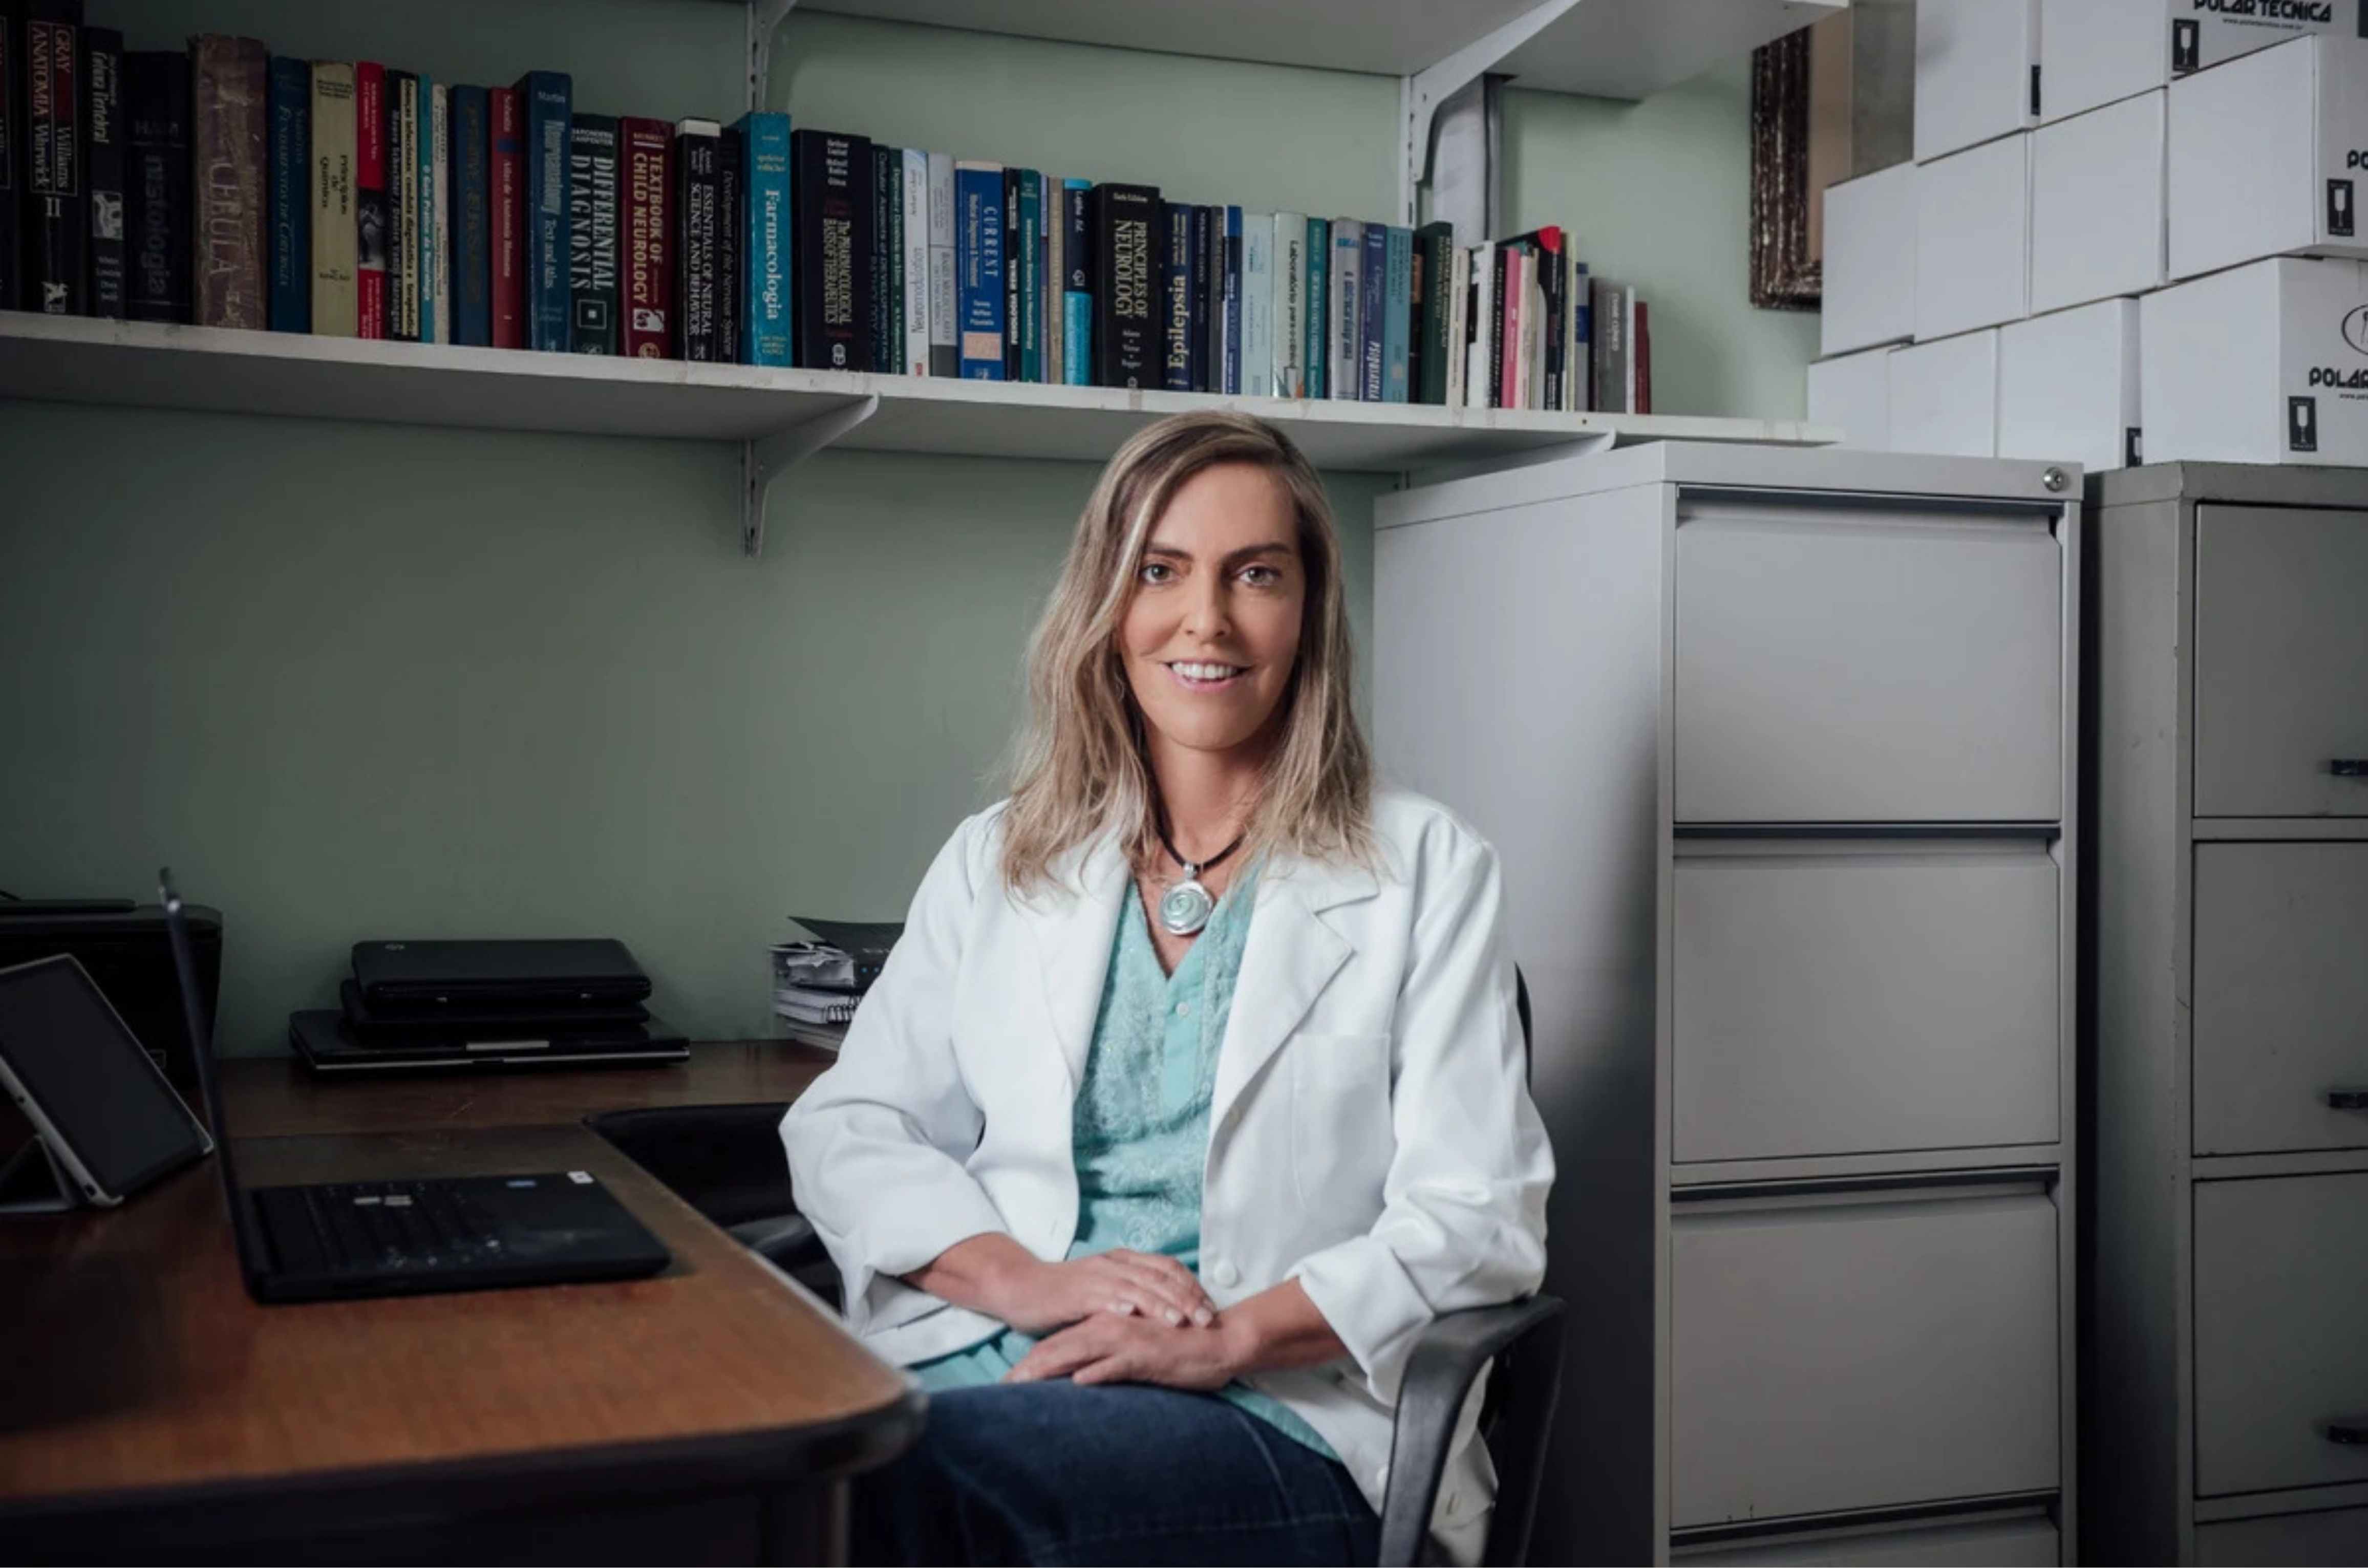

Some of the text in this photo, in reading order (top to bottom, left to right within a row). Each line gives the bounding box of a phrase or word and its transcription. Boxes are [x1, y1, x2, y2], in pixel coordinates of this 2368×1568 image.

[33, 29, 50, 186] ANATOMIA Warwick
[56, 29, 72, 188] GRAY Williams
[571, 155, 592, 289] DIAGNOSIS
[593, 157, 615, 290] DIFFERENTIAL
[632, 153, 648, 304] CHILD NEUROLOGY
[649, 154, 665, 265] TEXTBOOK OF
[689, 182, 702, 336] SCIENCE AND BEHAVIOR
[701, 184, 714, 336] ESSENTIALS OF NEURAL
[762, 188, 783, 320] Farmacologia
[983, 206, 998, 277] CURRENT
[1114, 219, 1133, 318] NEUROLOGY
[1133, 221, 1148, 318] PRINCIPLES OF
[1167, 275, 1190, 369] Epilepsia
